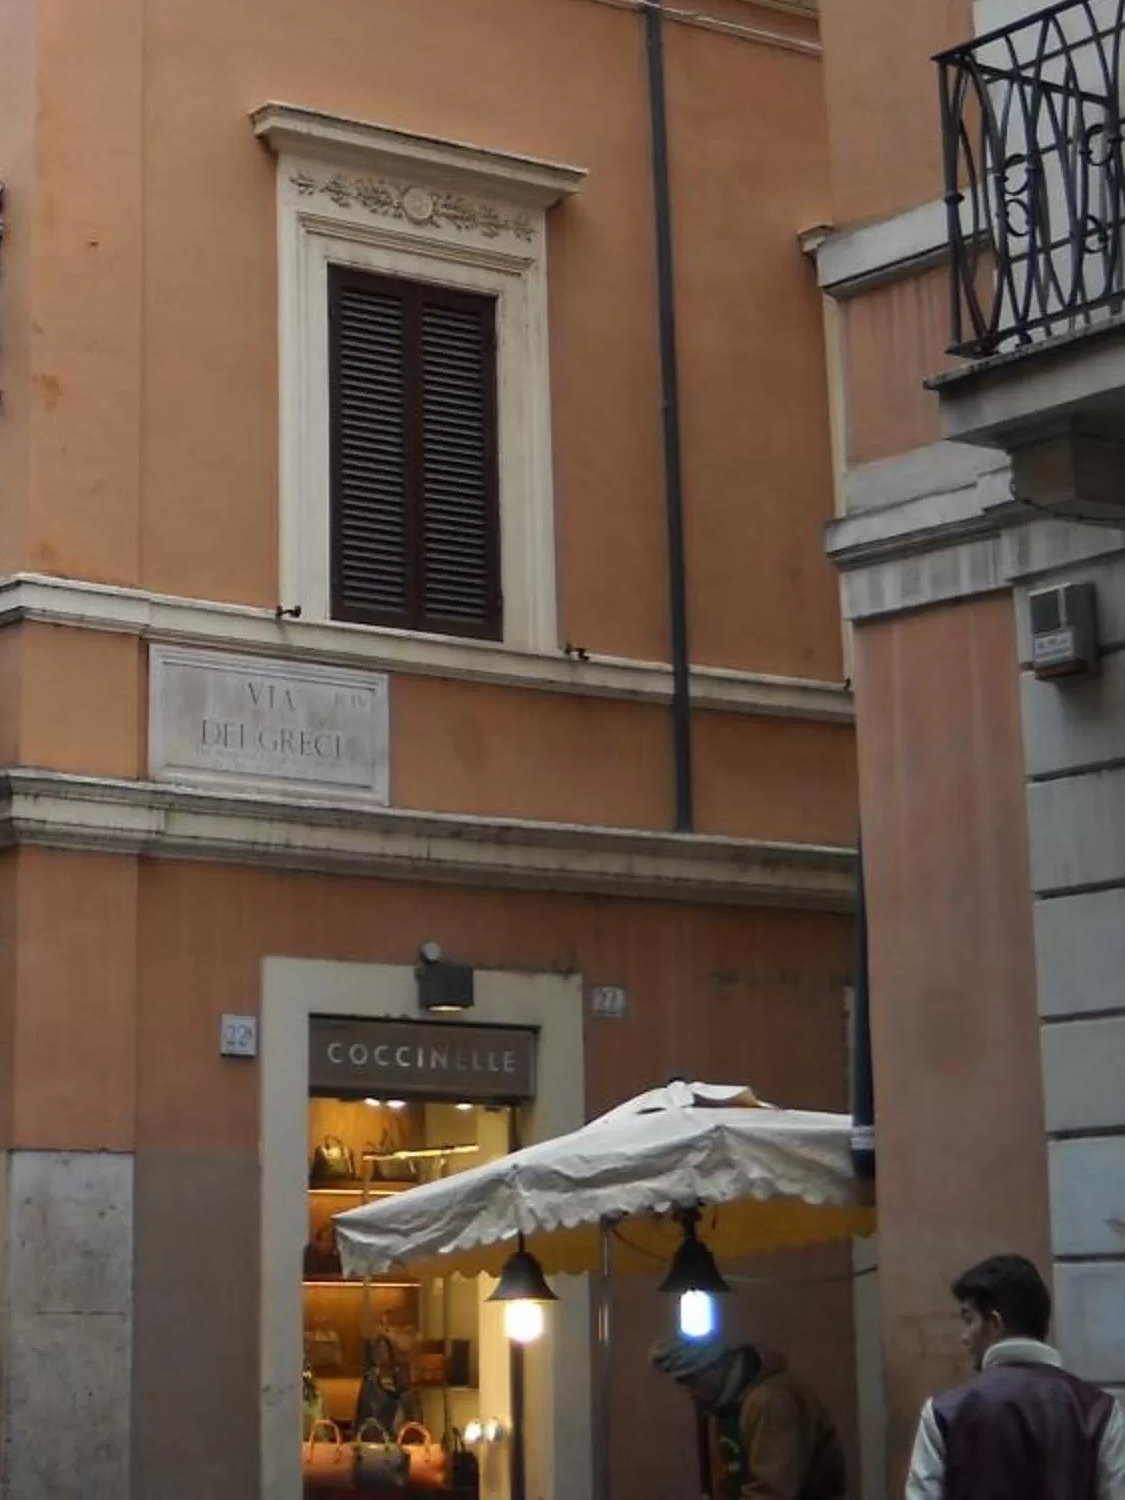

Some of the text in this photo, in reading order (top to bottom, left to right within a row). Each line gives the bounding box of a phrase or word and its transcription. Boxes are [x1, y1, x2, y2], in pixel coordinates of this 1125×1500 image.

[246, 681, 296, 713] VIA
[201, 719, 343, 758] DEI GRECI
[327, 1042, 516, 1072] COCCINELLE
